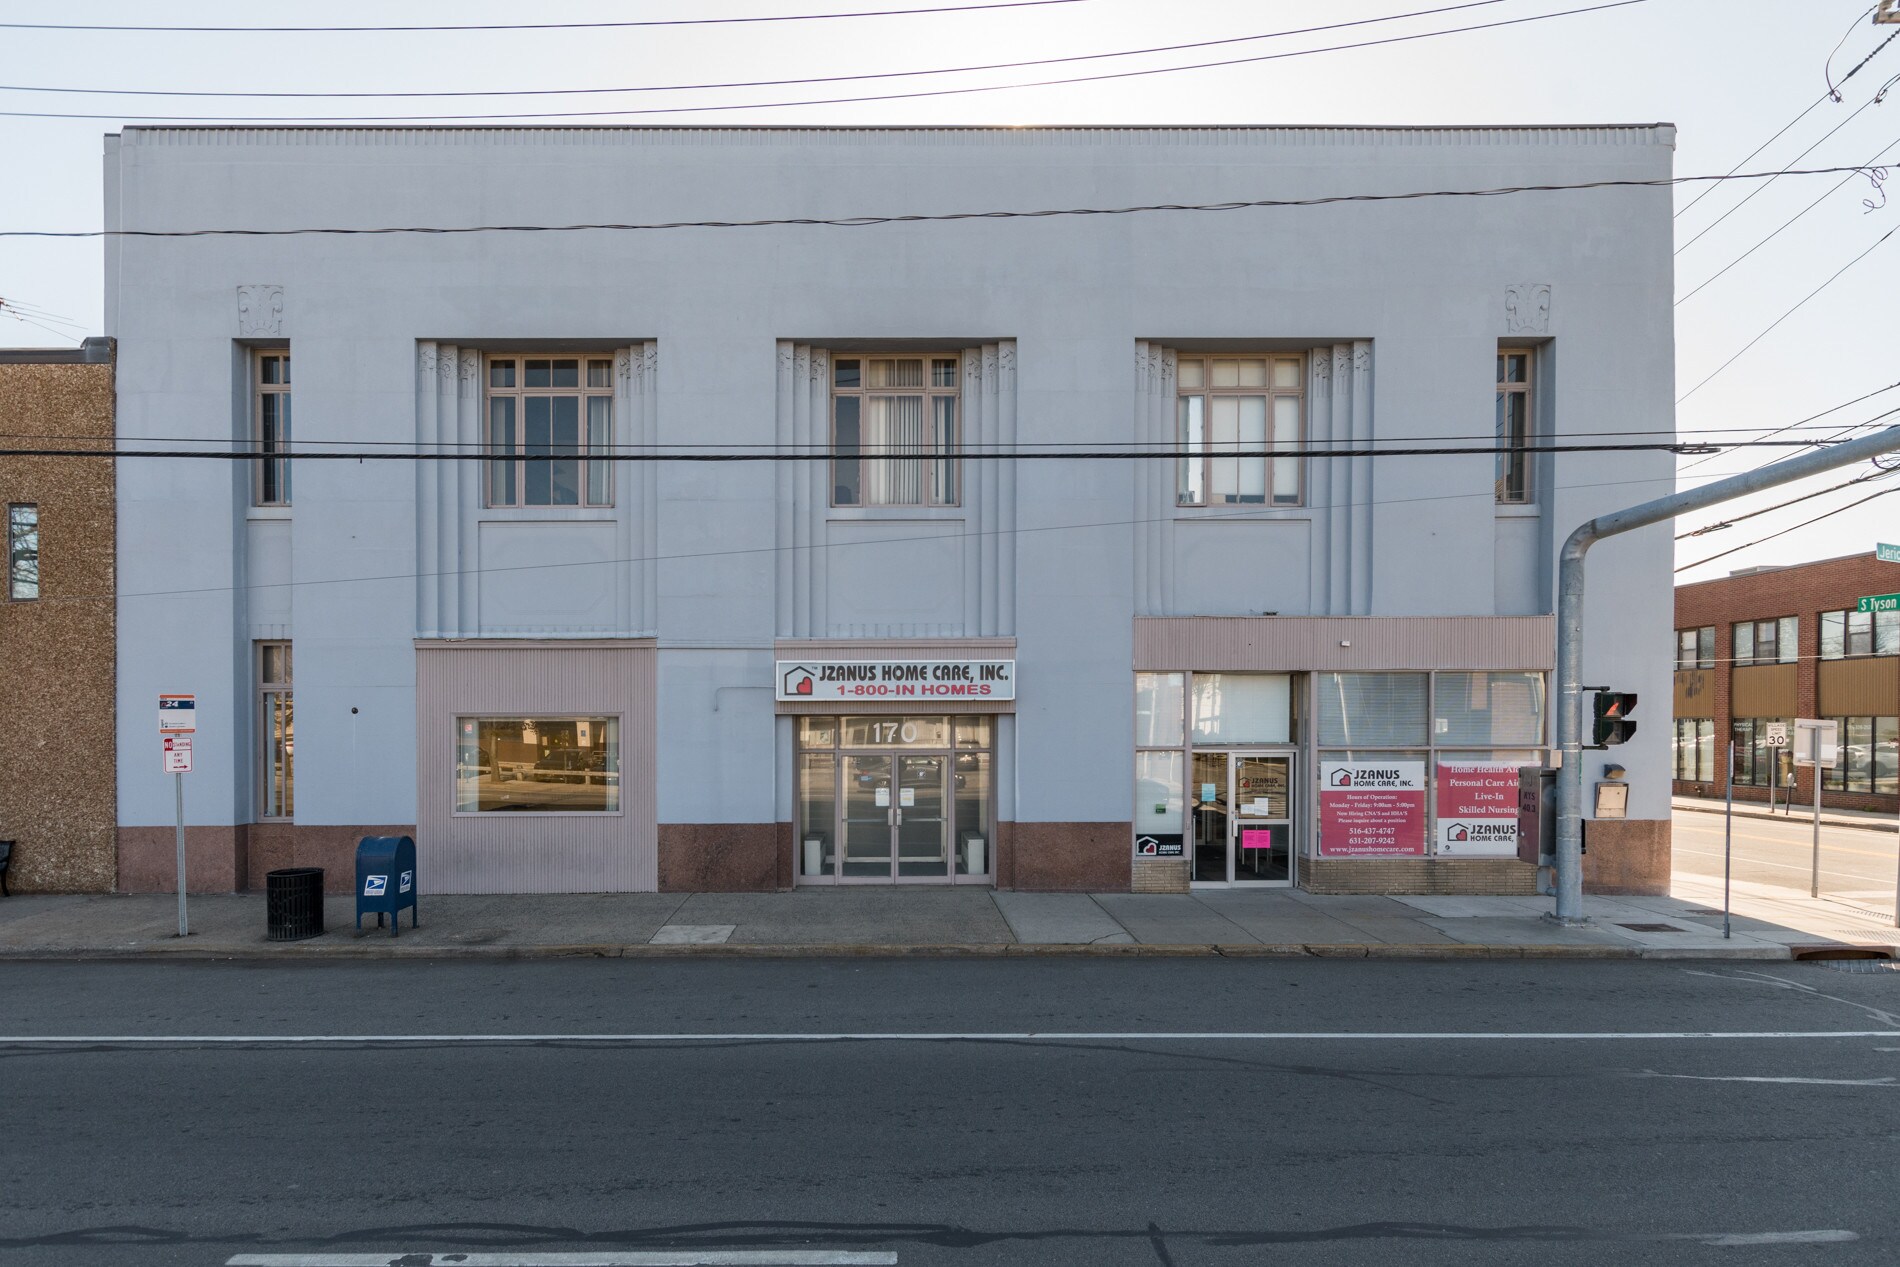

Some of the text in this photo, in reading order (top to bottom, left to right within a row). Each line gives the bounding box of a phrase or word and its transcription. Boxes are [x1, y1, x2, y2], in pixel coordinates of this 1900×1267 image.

[1861, 598, 1897, 612] S Tyson
[819, 665, 1009, 683] JZANUS HOME CARE, INC.
[837, 684, 992, 696] 1-800-IN HOMES
[873, 722, 917, 743] 170
[165, 741, 173, 749] NO
[1769, 736, 1785, 745] 30
[1353, 770, 1400, 779] JZANUS
[1378, 780, 1397, 788] CARE,
[1449, 779, 1483, 787] Personal
[1486, 779, 1504, 787] Care
[1475, 792, 1504, 800] Live-In
[1458, 806, 1486, 814] Skilled
[1470, 825, 1516, 834] JZANUS
